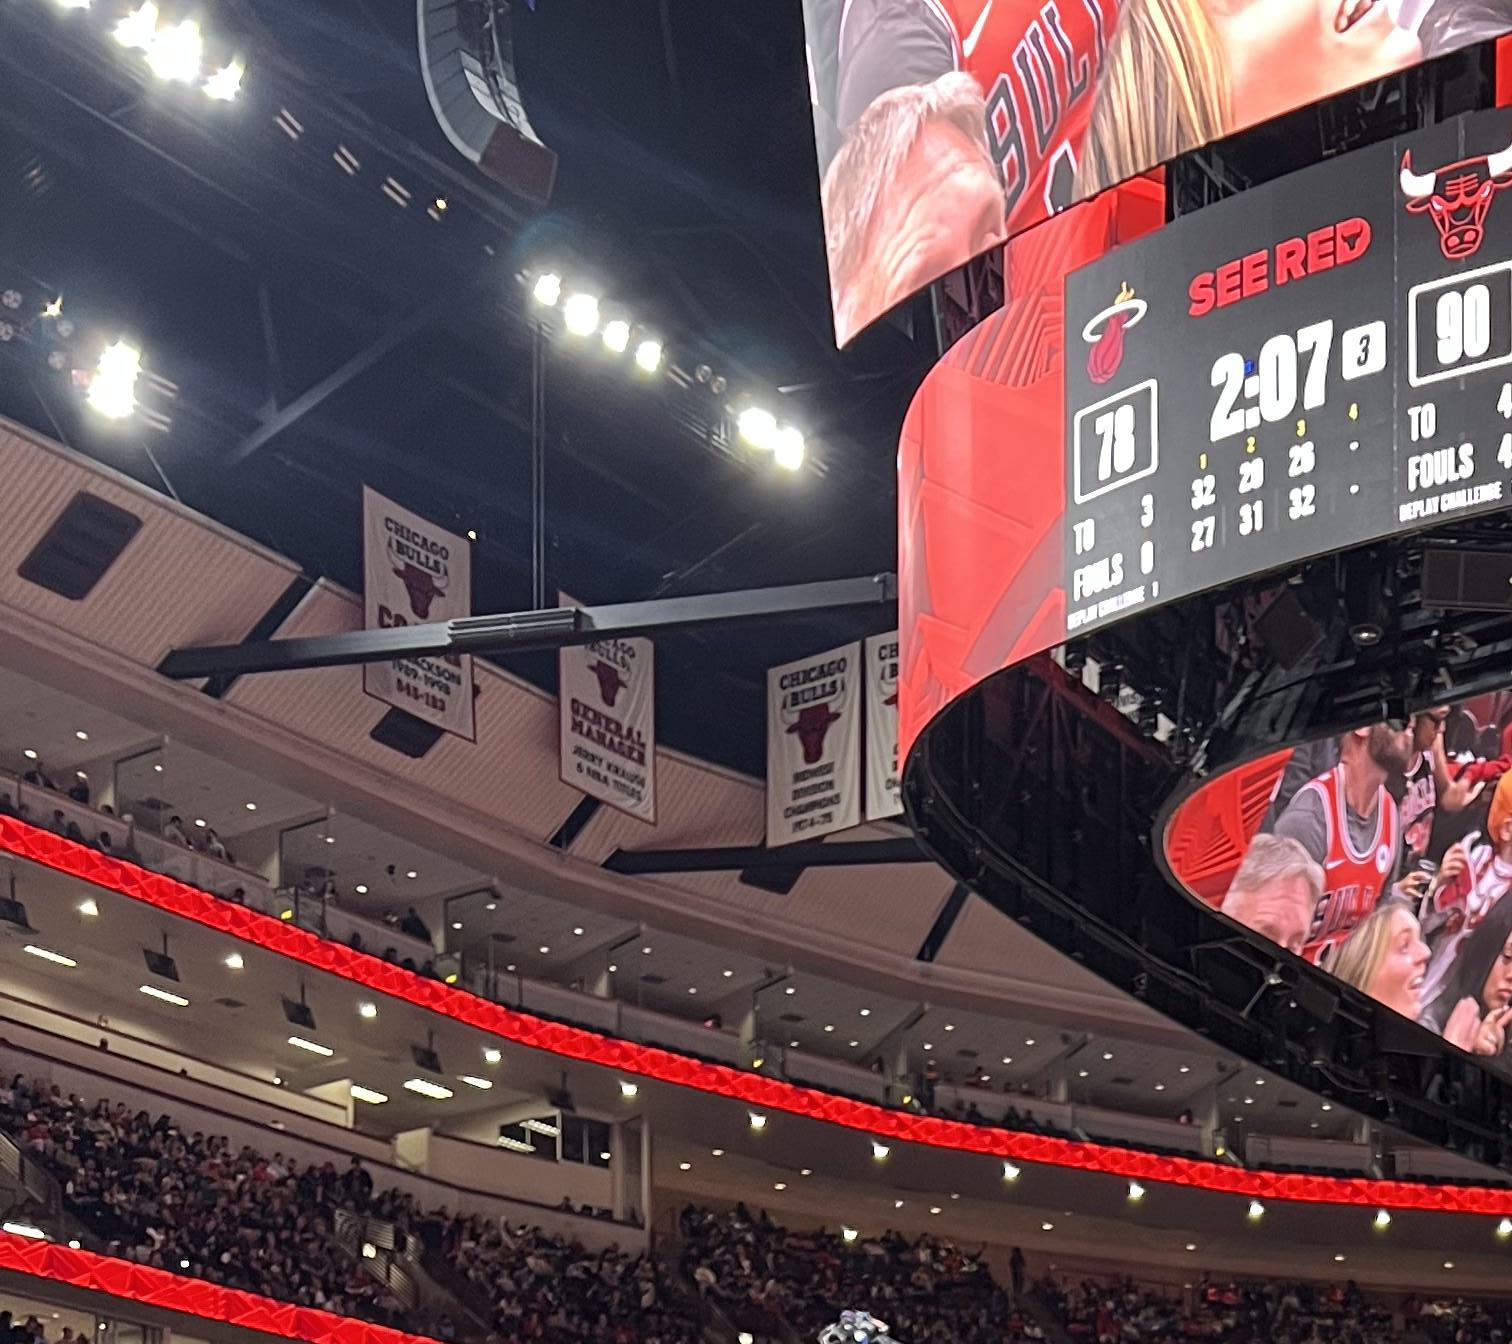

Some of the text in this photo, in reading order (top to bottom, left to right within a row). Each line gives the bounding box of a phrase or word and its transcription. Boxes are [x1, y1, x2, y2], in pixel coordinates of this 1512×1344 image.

[1187, 216, 1372, 317] SEE RED
[1436, 284, 1491, 366] 90
[1210, 319, 1371, 443] 2:07 3
[1095, 404, 1136, 481] 78
[1407, 402, 1436, 443] TO
[1191, 474, 1216, 511] 32
[1407, 442, 1475, 493] FOULS
[384, 516, 449, 561] CHICAGO
[1072, 493, 1154, 556] TO 3
[1191, 484, 1316, 553] 27 31 32
[395, 538, 441, 575] BULLS
[1073, 552, 1125, 603] FOULS
[779, 657, 847, 690] CHICAGO
[790, 679, 838, 708] BULLS
[571, 697, 645, 745] GENERAL
[571, 715, 646, 768] MANAGER
